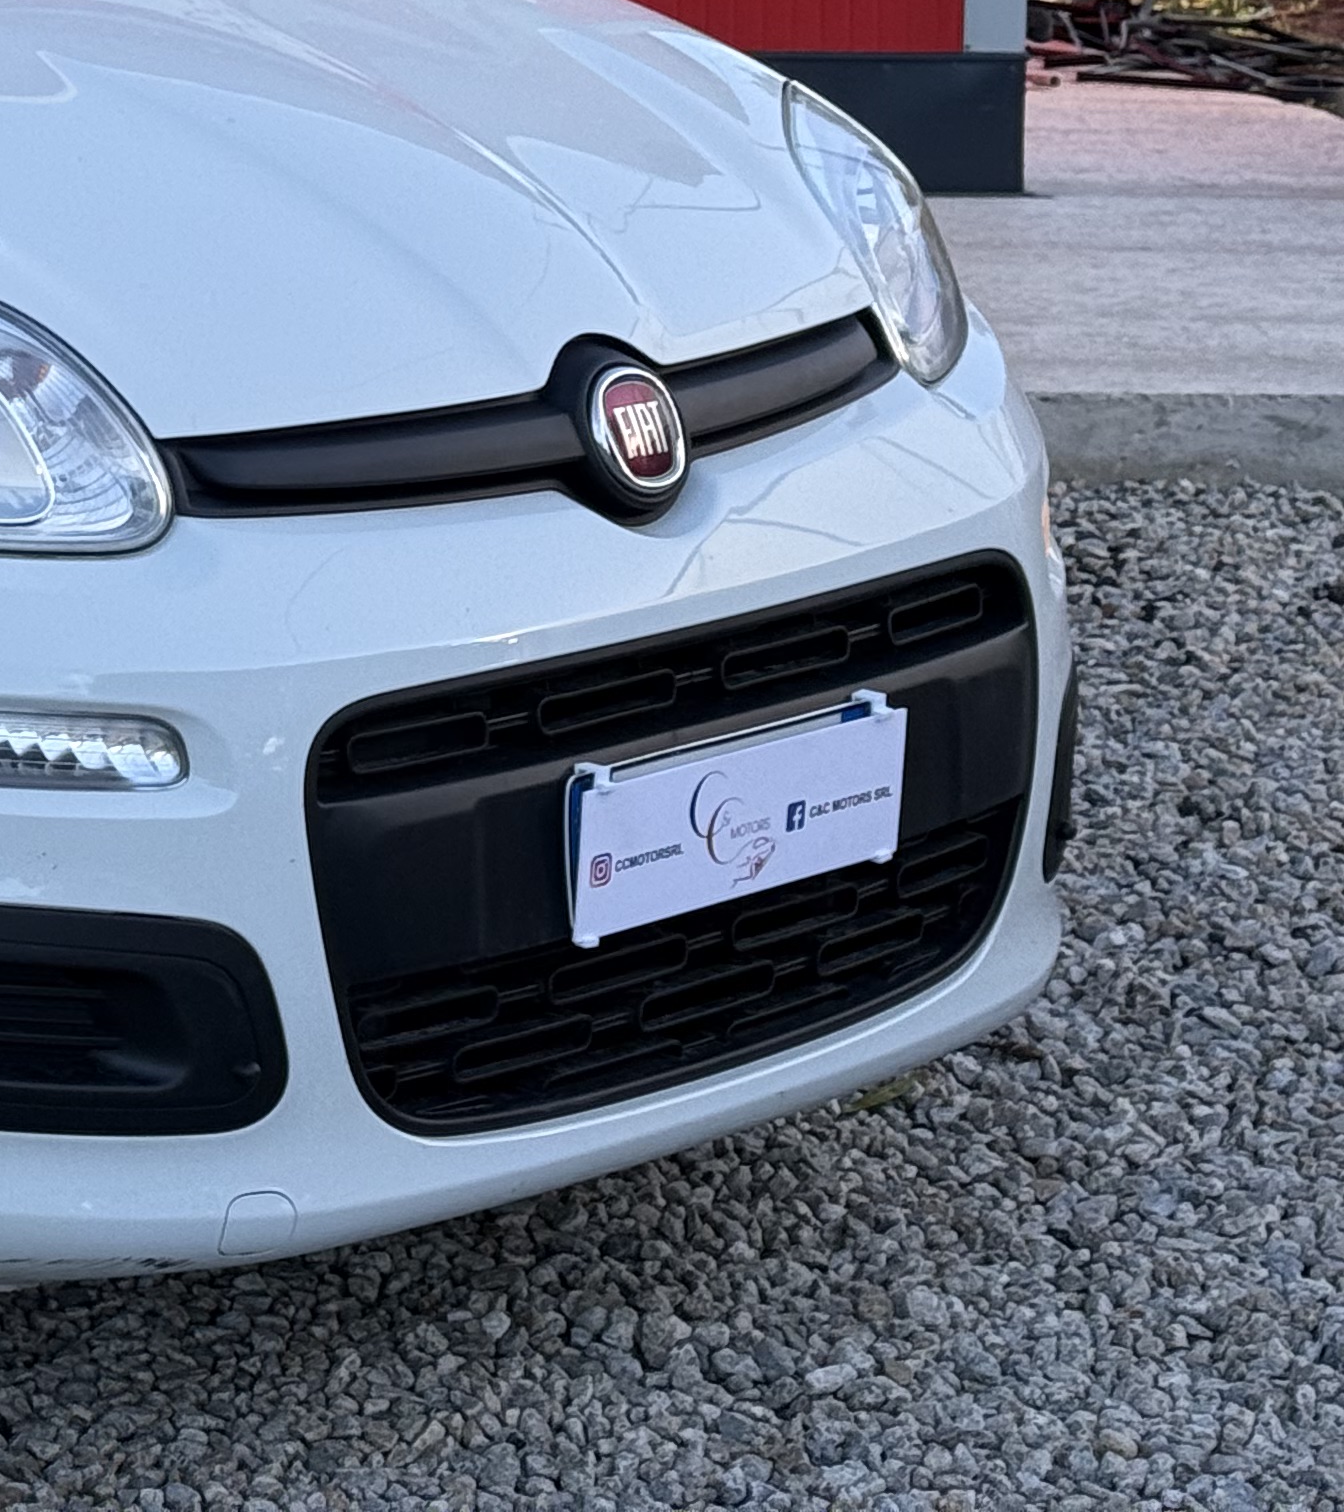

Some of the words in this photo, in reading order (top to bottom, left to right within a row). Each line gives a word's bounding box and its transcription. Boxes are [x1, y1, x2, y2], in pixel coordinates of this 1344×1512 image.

[613, 400, 669, 459] FIAT
[809, 801, 831, 819] C&C
[832, 790, 872, 812] MOTORS
[874, 786, 893, 801] SRL
[730, 817, 771, 839] MOTORS
